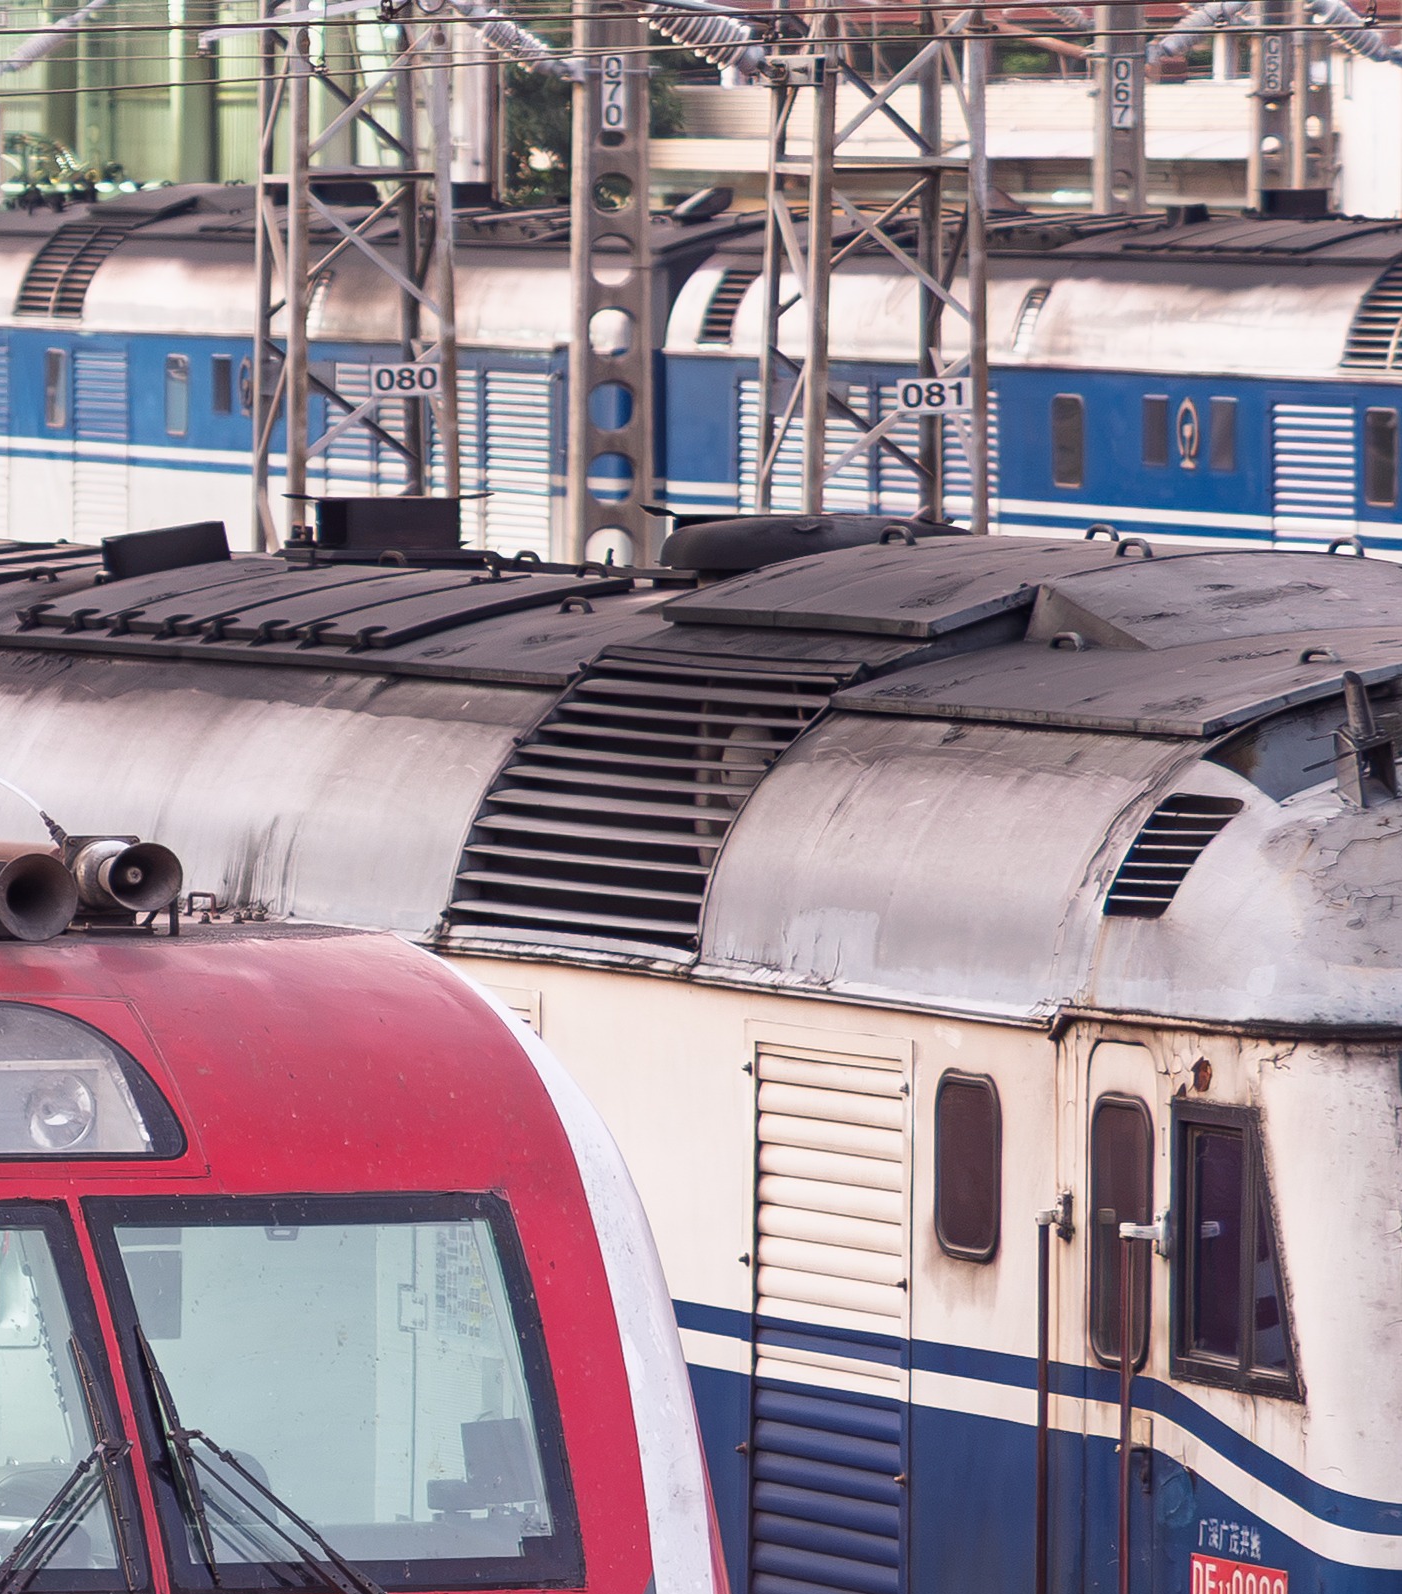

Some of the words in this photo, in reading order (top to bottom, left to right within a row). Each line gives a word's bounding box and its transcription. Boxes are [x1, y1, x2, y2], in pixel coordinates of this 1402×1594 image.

[605, 56, 623, 127] 070
[1114, 60, 1131, 124] 067
[376, 367, 438, 391] 080
[902, 381, 963, 408] 081
